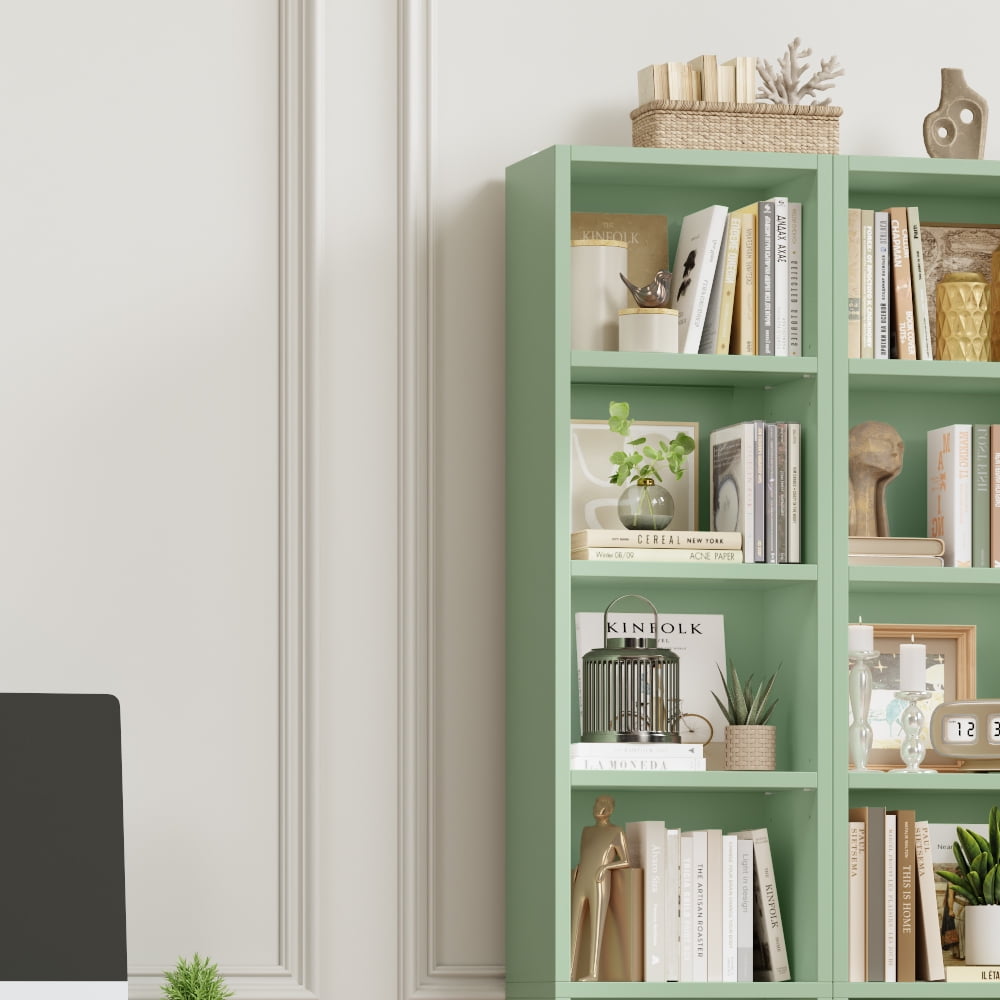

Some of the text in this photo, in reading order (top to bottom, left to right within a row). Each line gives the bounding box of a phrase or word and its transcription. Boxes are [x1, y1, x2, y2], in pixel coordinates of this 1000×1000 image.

[582, 230, 640, 245] KINFOLK
[891, 219, 902, 268] CHAPMAN
[637, 534, 681, 545] CEREAL
[686, 536, 703, 545] NEW
[705, 536, 724, 545] YORK
[689, 552, 735, 561] ACNE PAPER
[607, 622, 703, 635] KINFOLK
[956, 721, 975, 737] 12
[921, 827, 930, 853] PAUL
[915, 827, 926, 878] SIETSEMA
[741, 853, 749, 874] Light
[741, 885, 749, 913] design
[765, 883, 779, 929] KINFOLK
[902, 864, 911, 934] THIS IS HOME
[981, 971, 987, 980] IL
